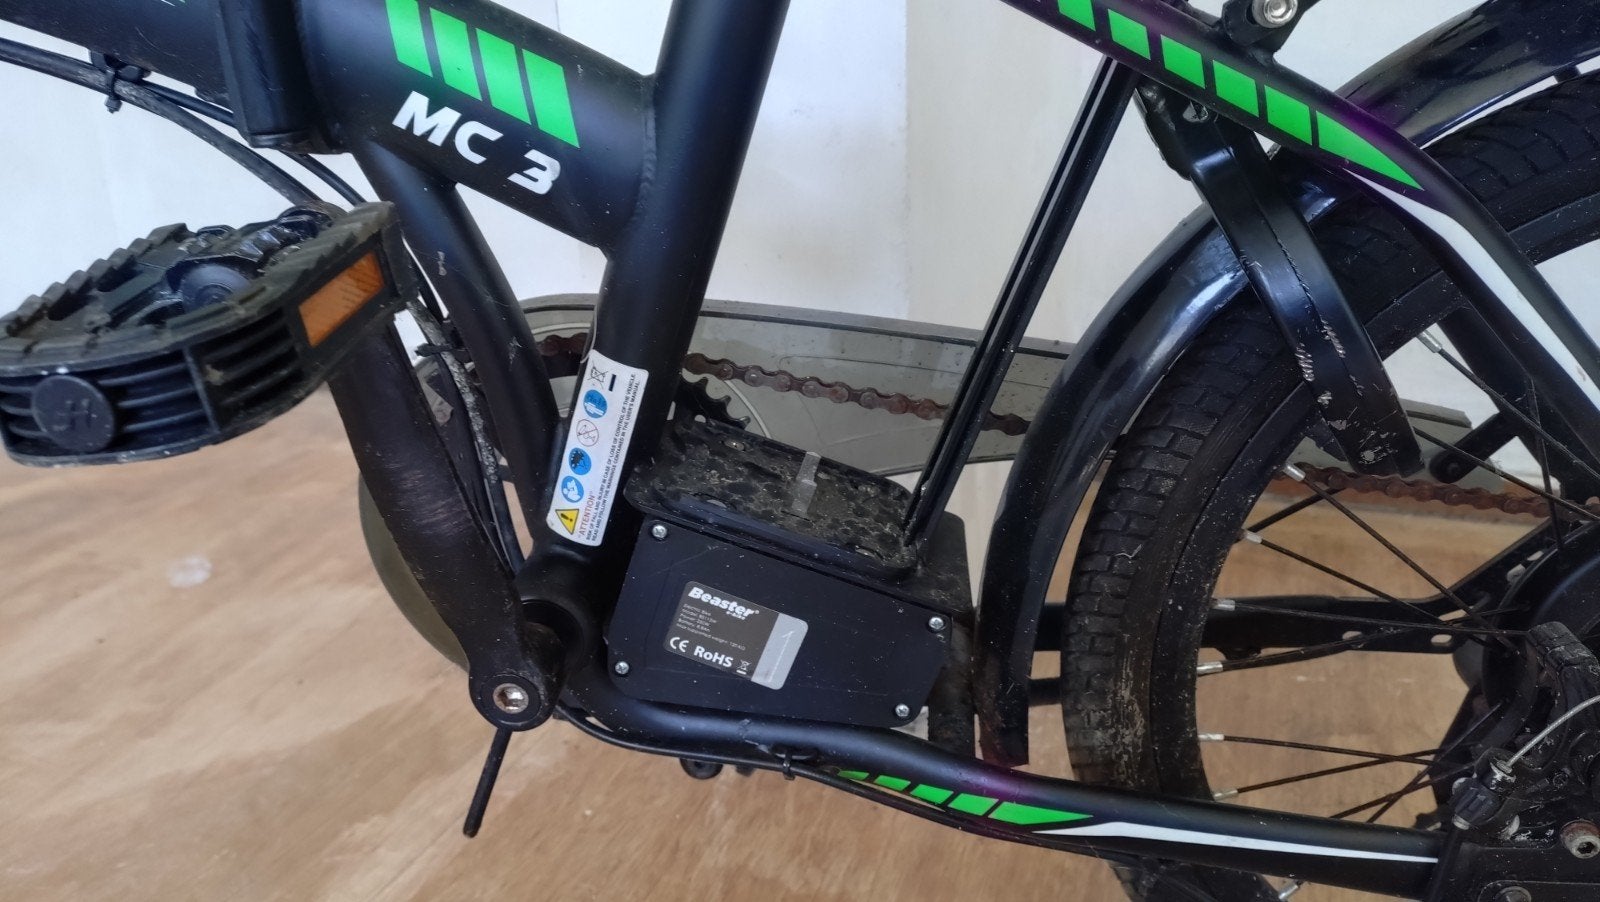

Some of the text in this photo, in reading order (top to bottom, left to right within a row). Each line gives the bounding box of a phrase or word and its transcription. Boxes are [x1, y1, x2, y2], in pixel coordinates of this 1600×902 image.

[392, 90, 561, 195] MC 3
[614, 414, 624, 437] CONTROL
[612, 437, 617, 445] OF
[597, 498, 606, 518] FOLLOW
[606, 464, 616, 489] WARNINGS
[613, 436, 624, 464] CONTAINED
[693, 645, 734, 668] RoHS
